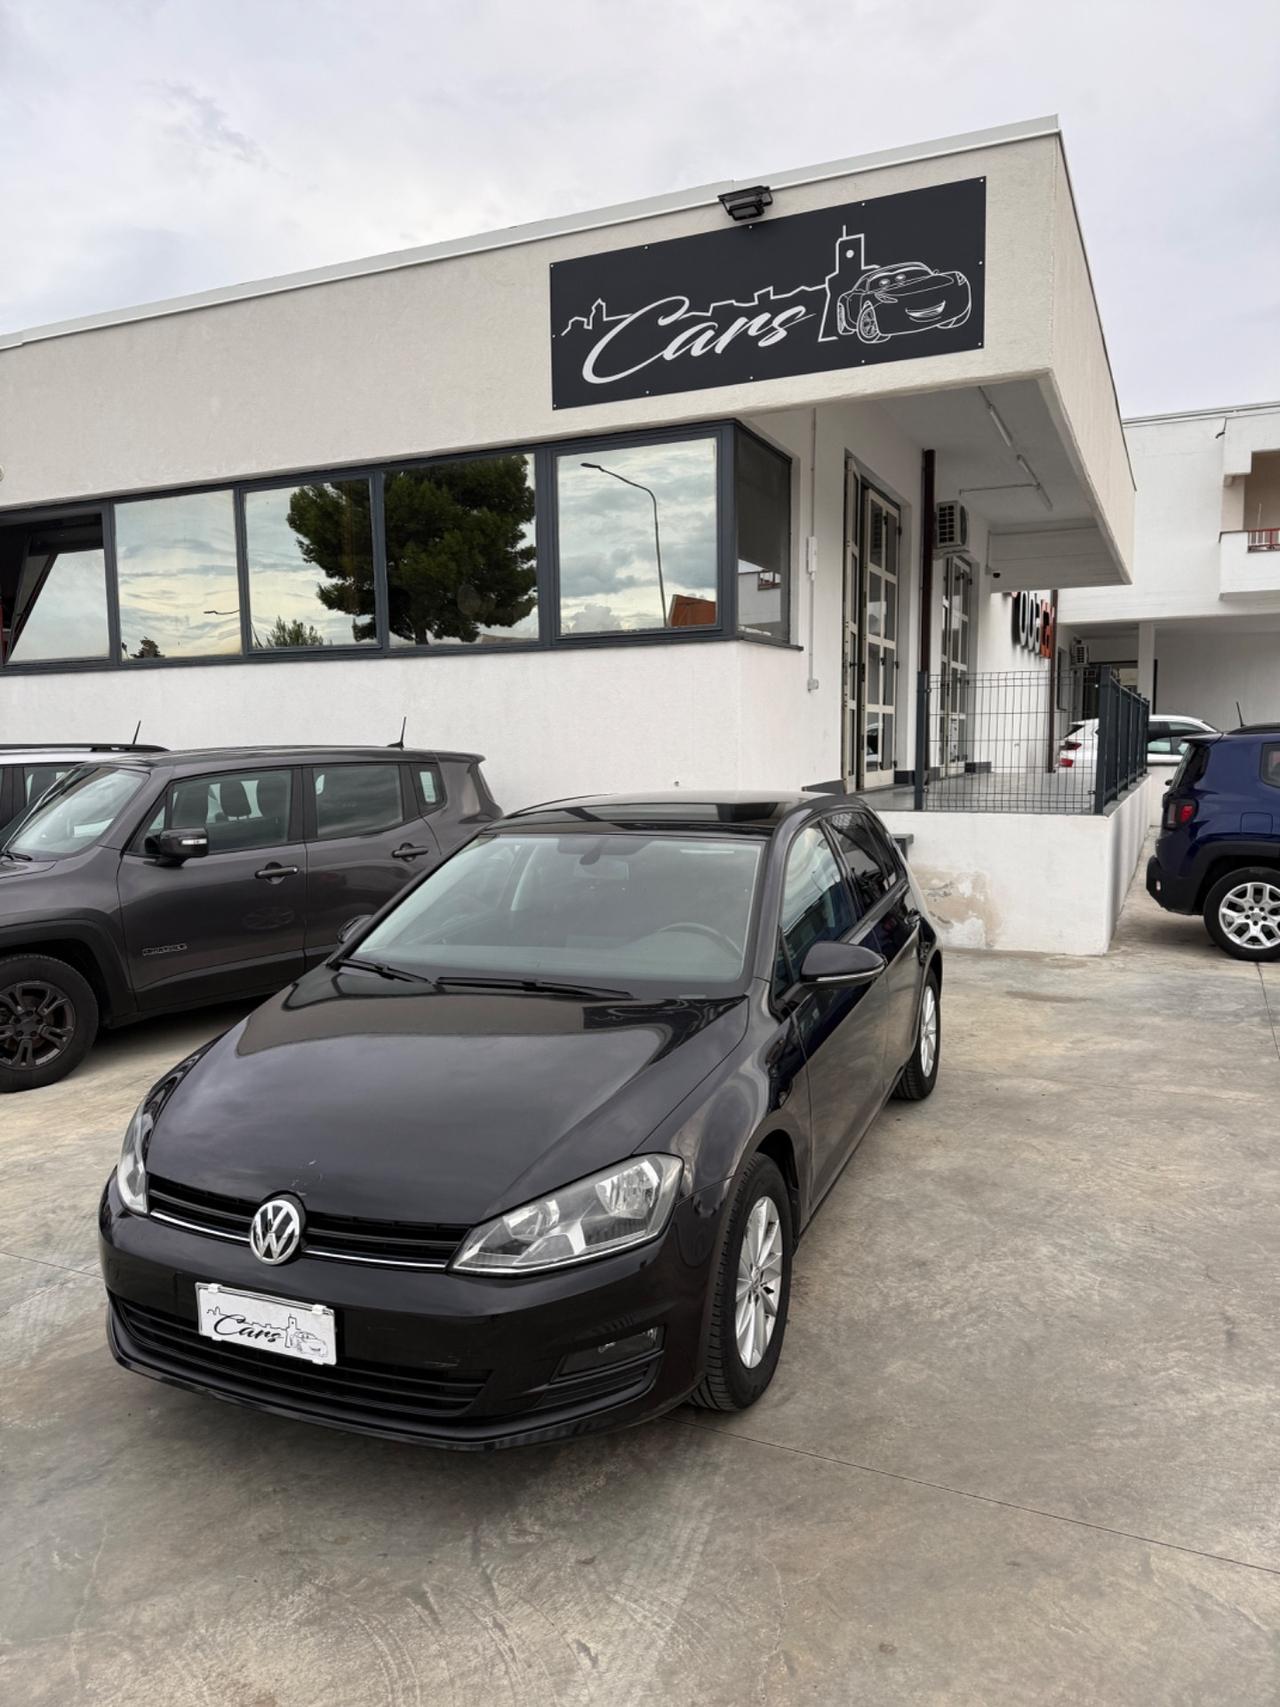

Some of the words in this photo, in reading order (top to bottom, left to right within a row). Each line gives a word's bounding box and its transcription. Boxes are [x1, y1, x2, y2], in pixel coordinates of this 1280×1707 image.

[582, 295, 814, 384] Cars
[251, 1199, 300, 1266] VW
[214, 1313, 283, 1343] Cars
